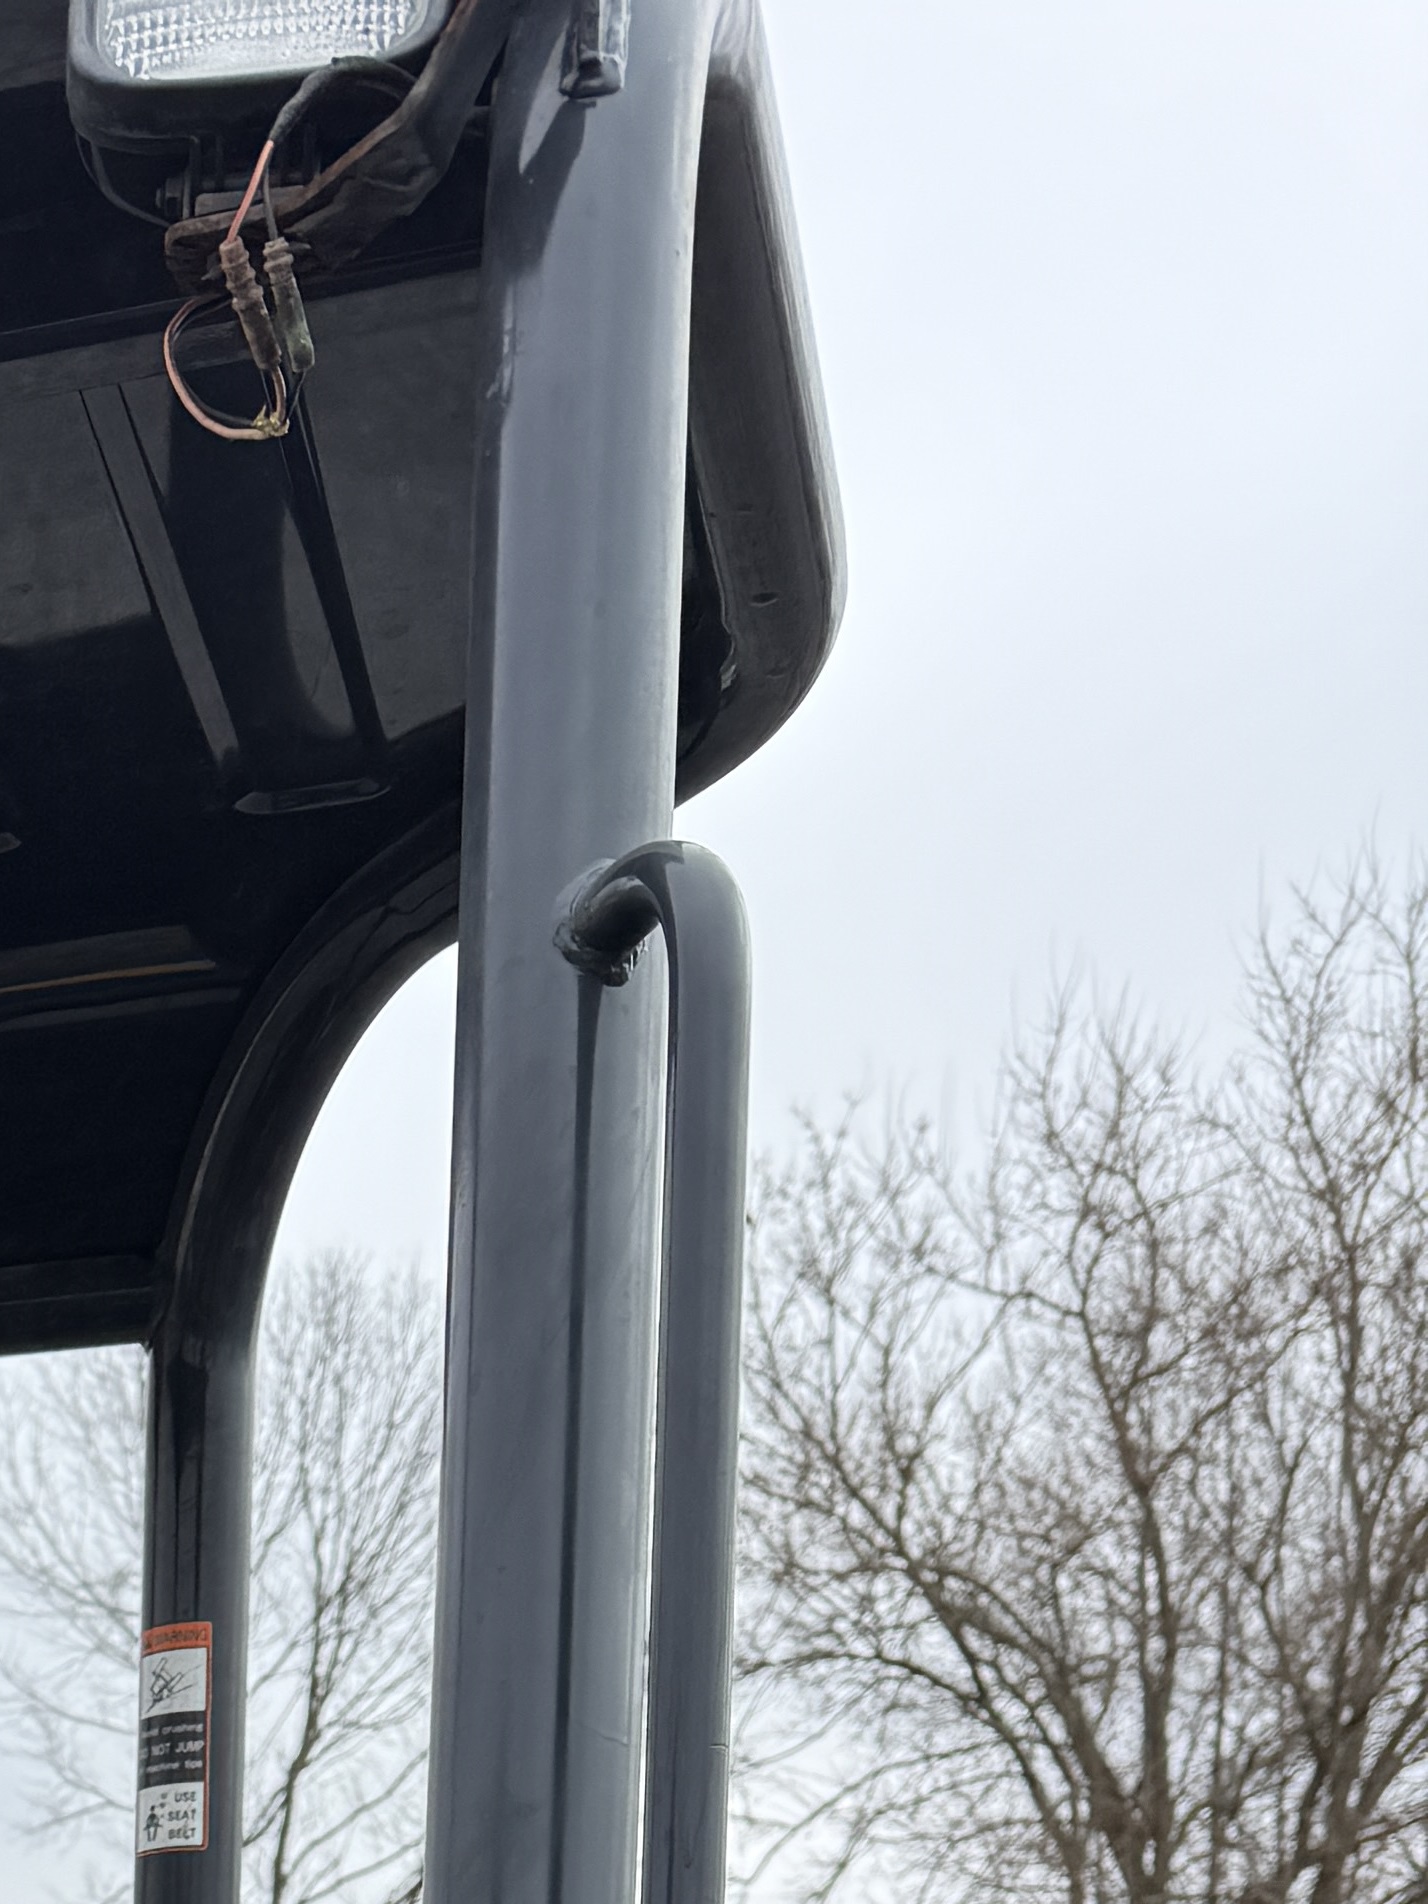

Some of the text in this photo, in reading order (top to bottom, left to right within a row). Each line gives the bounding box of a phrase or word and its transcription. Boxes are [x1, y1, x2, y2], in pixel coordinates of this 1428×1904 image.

[175, 1740, 204, 1753] JUMP
[175, 1791, 196, 1803] USE
[168, 1809, 196, 1822] SEAT
[168, 1827, 196, 1840] BELT
